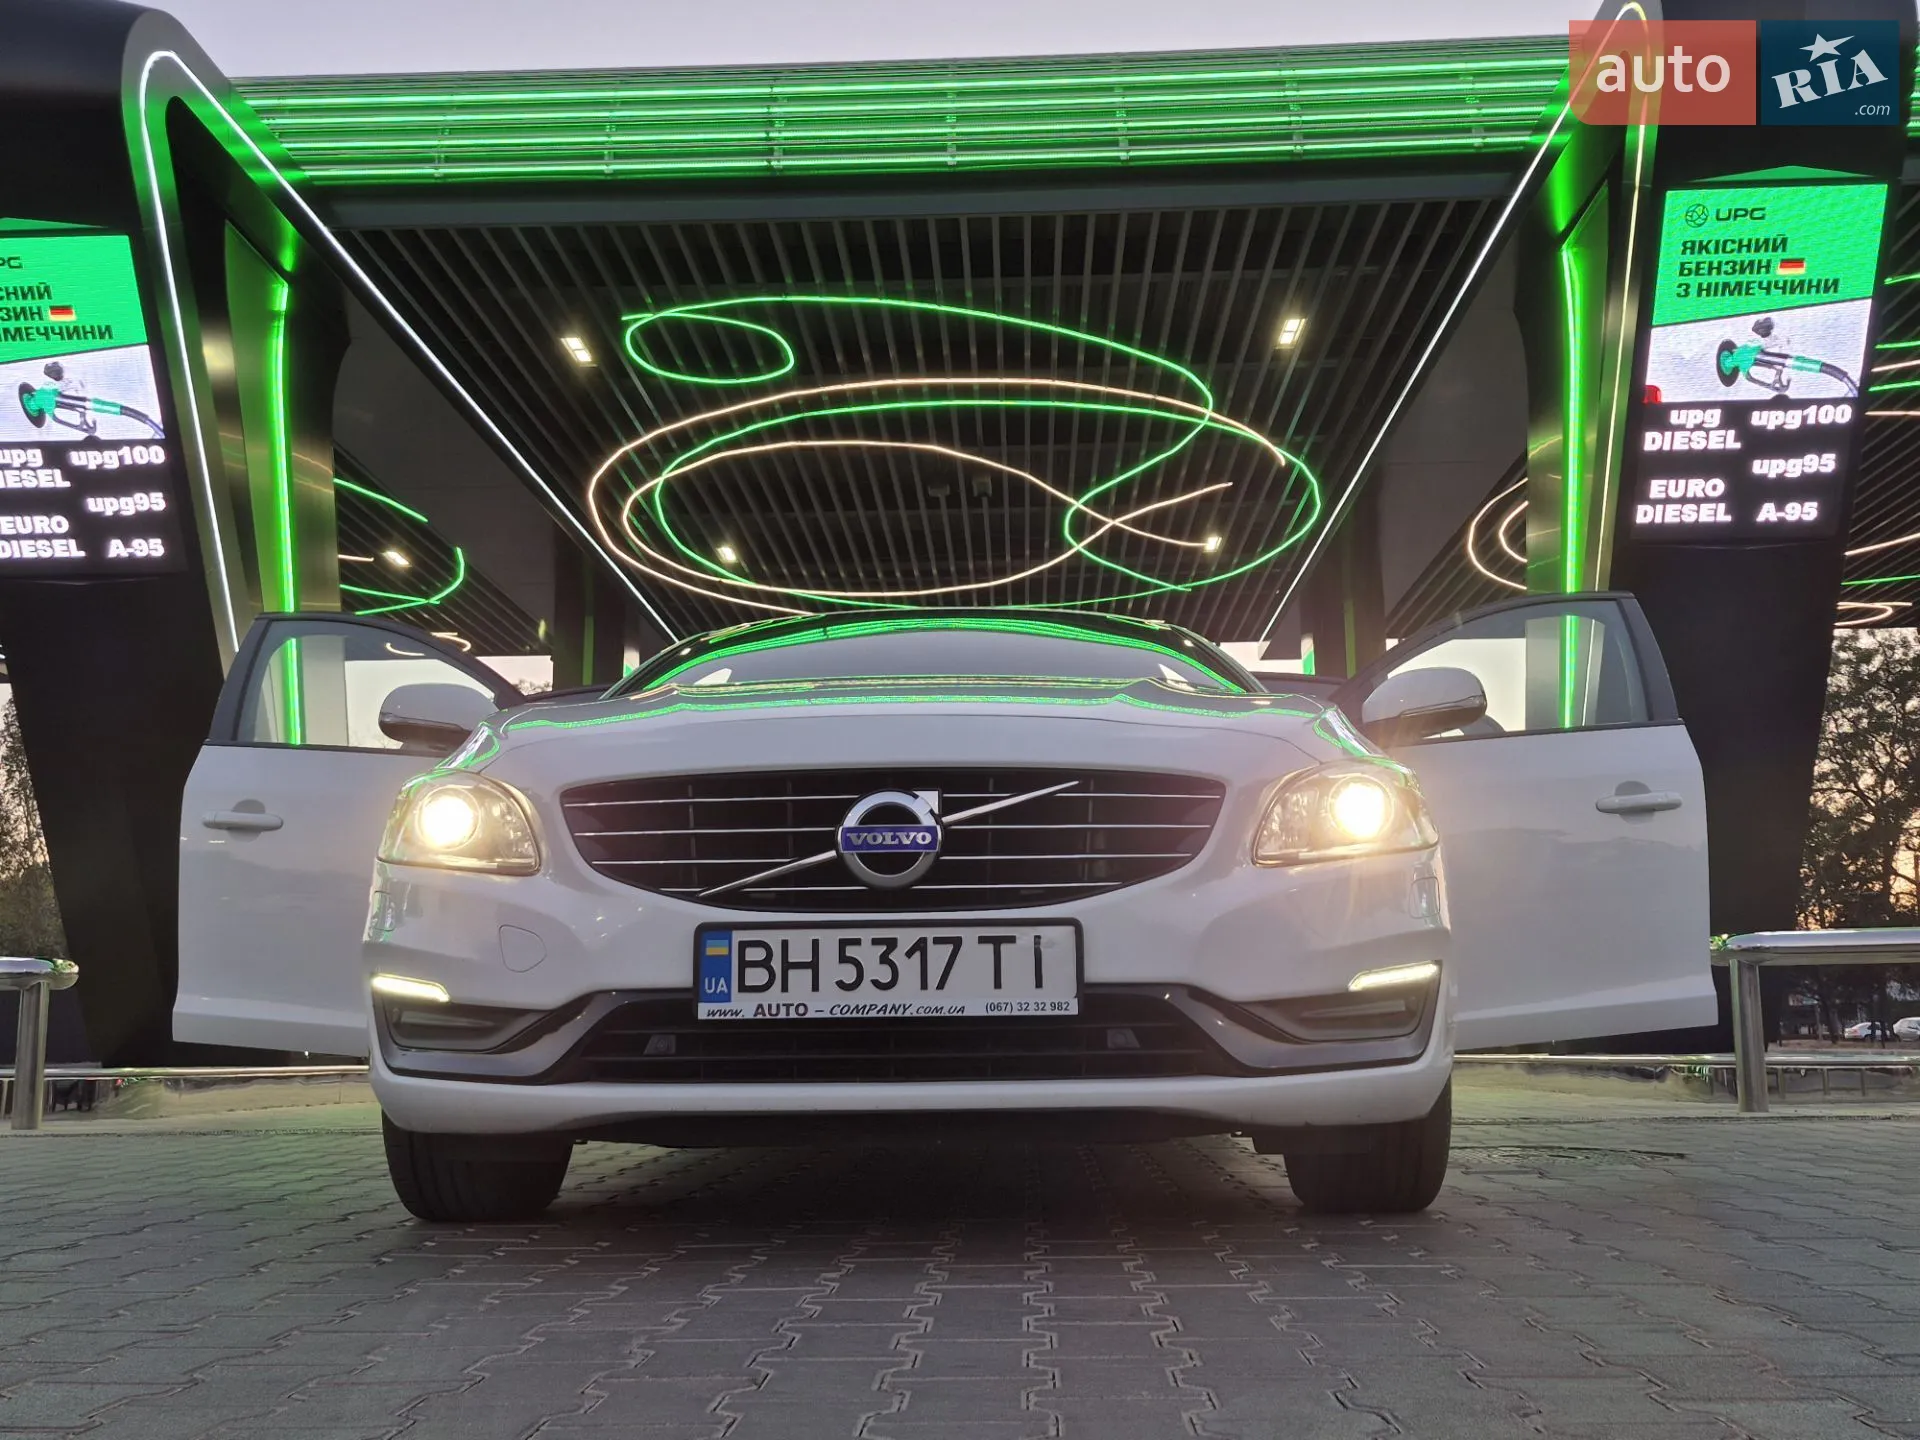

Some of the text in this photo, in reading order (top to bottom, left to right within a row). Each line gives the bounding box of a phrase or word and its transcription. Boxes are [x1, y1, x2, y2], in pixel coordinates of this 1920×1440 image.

[1715, 207, 1766, 222] UPG
[1681, 234, 1788, 256] ЯКІСНИЙ
[1678, 259, 1772, 277] БЕНЗИН
[1696, 278, 1840, 298] НІМЕЧЧИНИ
[0, 325, 113, 342] МЕЧЧИНИ
[1670, 408, 1721, 429] upg
[1751, 404, 1852, 430] upg100
[1643, 430, 1741, 451] DIESEL
[69, 445, 165, 469] upg100
[1752, 453, 1836, 478] upg95
[1650, 478, 1725, 499] EURO
[86, 492, 166, 516] upg95
[1636, 502, 1732, 524] DIESEL
[1756, 501, 1818, 523] A-95
[0, 515, 69, 535] EURO
[107, 538, 165, 558] A-95
[846, 831, 932, 846] VOLVO
[705, 977, 728, 994] UA
[753, 1003, 809, 1017] AUTO
[985, 1001, 1070, 1014] (067) 32 32 982
